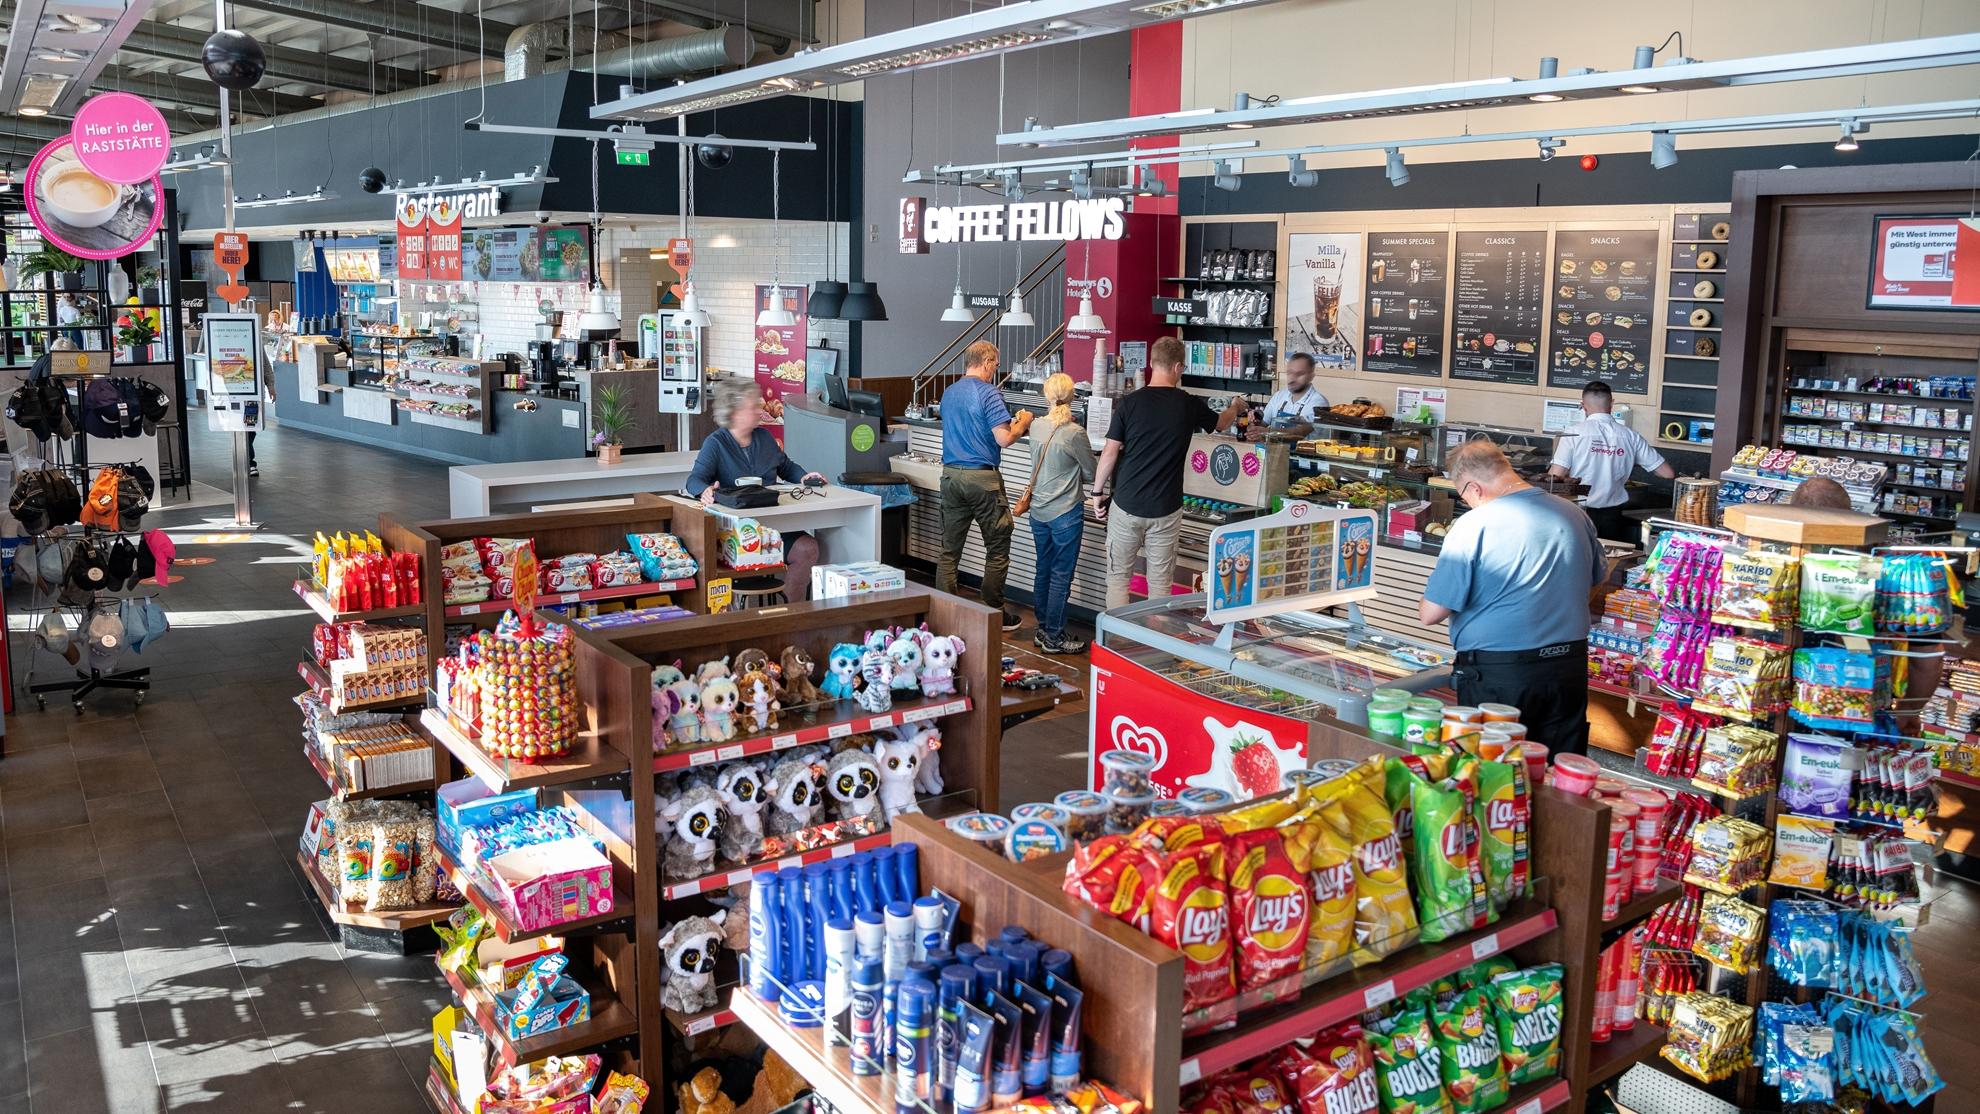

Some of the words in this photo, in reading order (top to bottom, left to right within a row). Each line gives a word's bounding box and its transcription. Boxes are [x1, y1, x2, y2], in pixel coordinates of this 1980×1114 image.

[85, 123, 112, 136] Hier
[116, 122, 128, 134] in
[132, 120, 154, 132] der
[82, 136, 163, 154] RASTSTÄTTE
[923, 204, 1005, 244] COFFEE
[1008, 197, 1125, 241] FELLOWS
[224, 235, 239, 244] HIER
[1890, 241, 1920, 249] günstig
[1318, 246, 1341, 256] Milla
[222, 256, 240, 264] HERE!
[448, 257, 458, 270] WC
[1304, 259, 1336, 269] Vanilla
[971, 296, 999, 306] AUSGABE
[1167, 302, 1193, 312] KASSE
[1733, 564, 1773, 576] HARIBO
[1801, 756, 1840, 769] Em-euk
[1250, 892, 1302, 933] Lay's
[530, 1013, 555, 1033] DIPS
[1387, 1046, 1441, 1098] BUGLES
[634, 1082, 649, 1098] Dip
[1323, 1066, 1379, 1114] BUGLES
